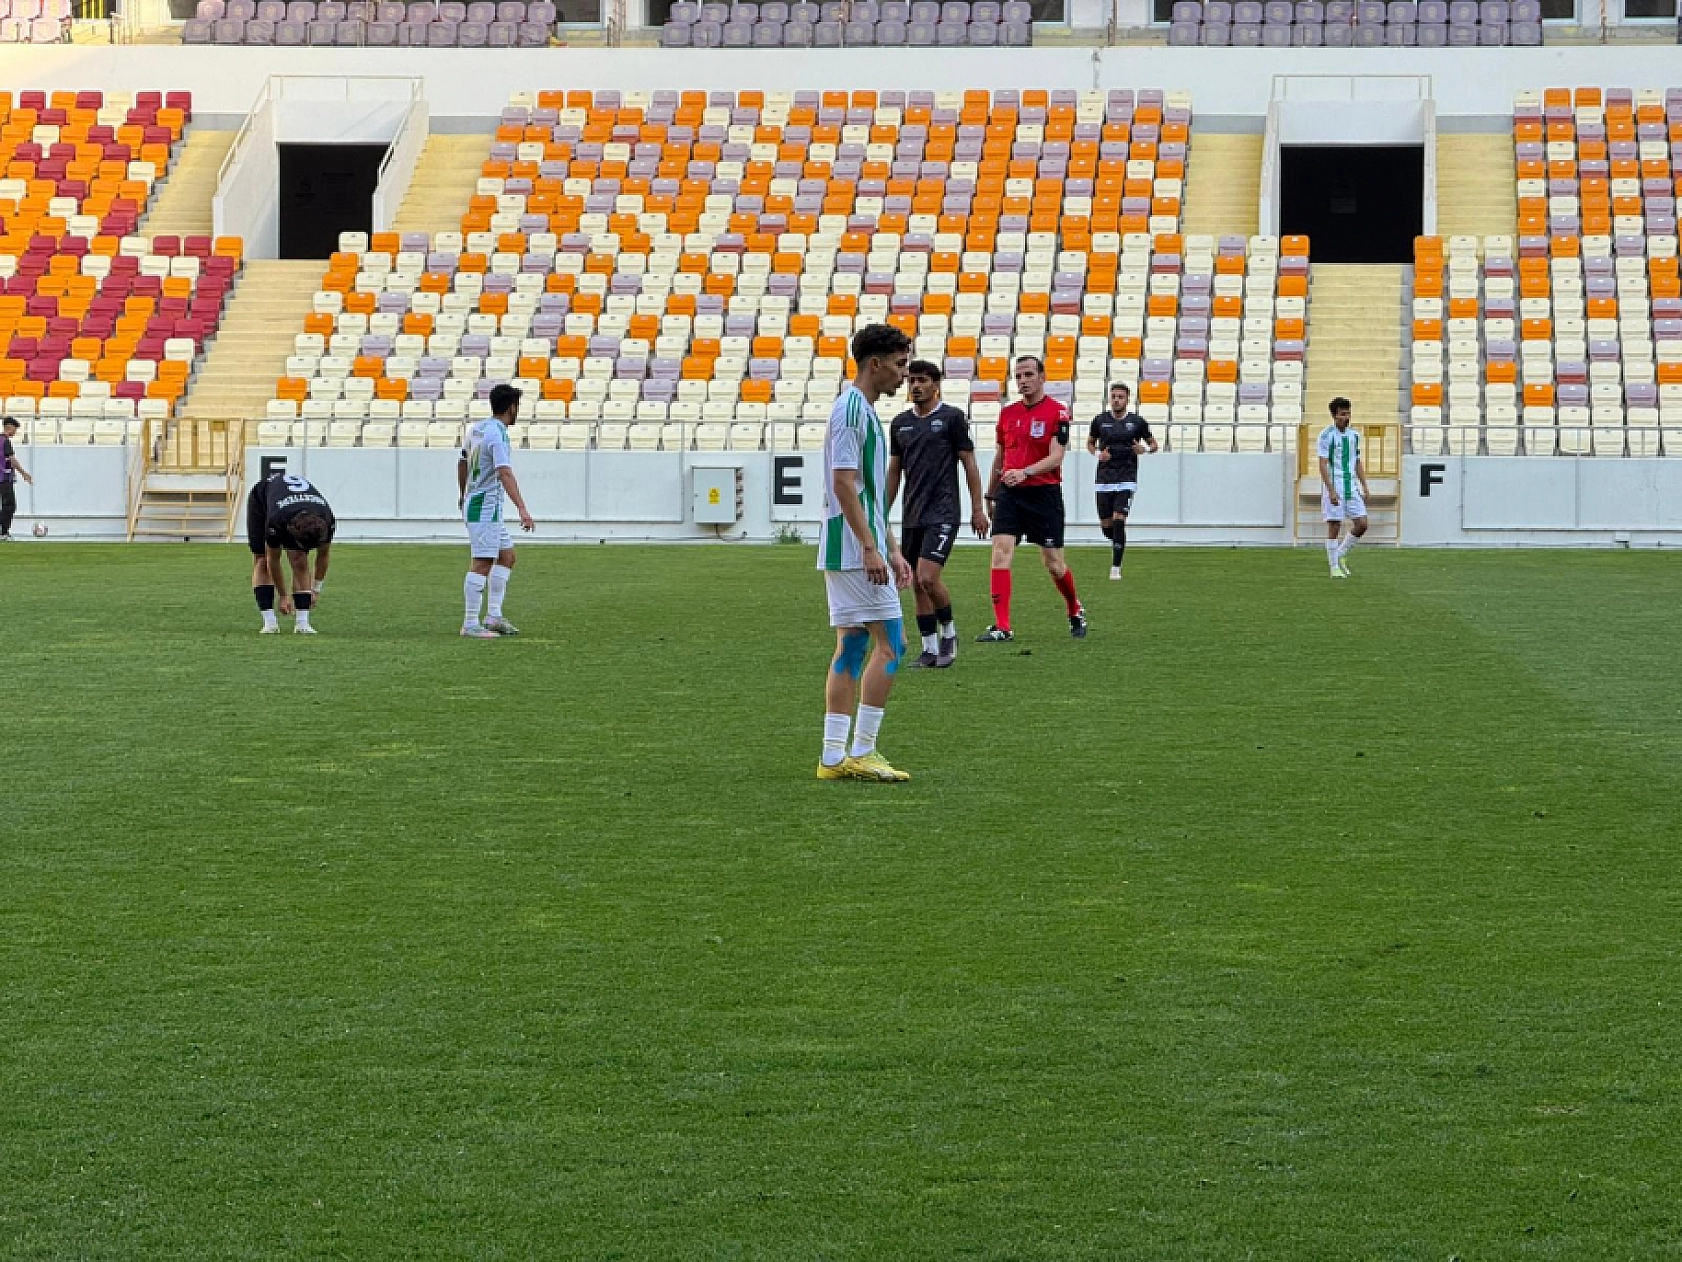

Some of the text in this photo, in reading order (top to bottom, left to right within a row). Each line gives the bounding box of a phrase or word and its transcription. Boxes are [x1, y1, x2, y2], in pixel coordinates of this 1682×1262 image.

[774, 456, 803, 505] E
[1420, 464, 1445, 497] F
[937, 534, 949, 551] 7
